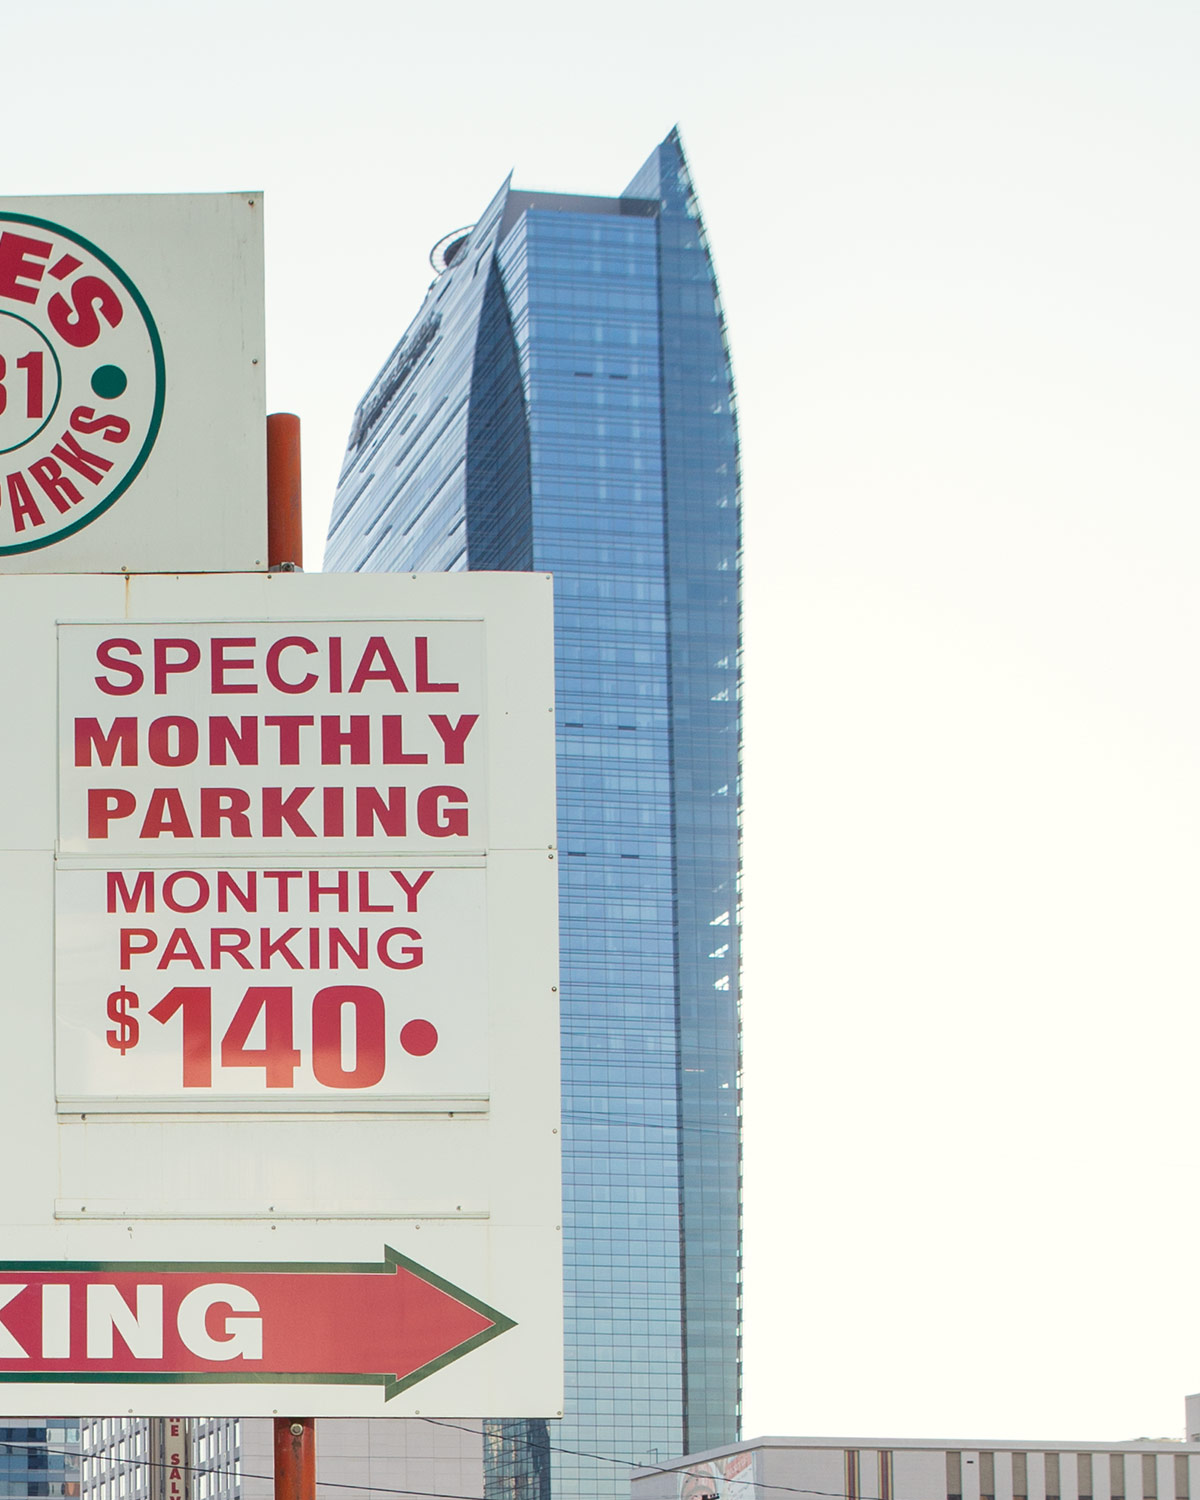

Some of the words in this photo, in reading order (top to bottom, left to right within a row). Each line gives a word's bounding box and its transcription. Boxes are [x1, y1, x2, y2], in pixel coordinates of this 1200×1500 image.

[95, 636, 459, 696] SPECIAL
[74, 714, 479, 768] MONTHLY
[87, 785, 469, 839] PARKING
[106, 870, 434, 914] MONTHLY
[119, 927, 424, 971] PARKING
